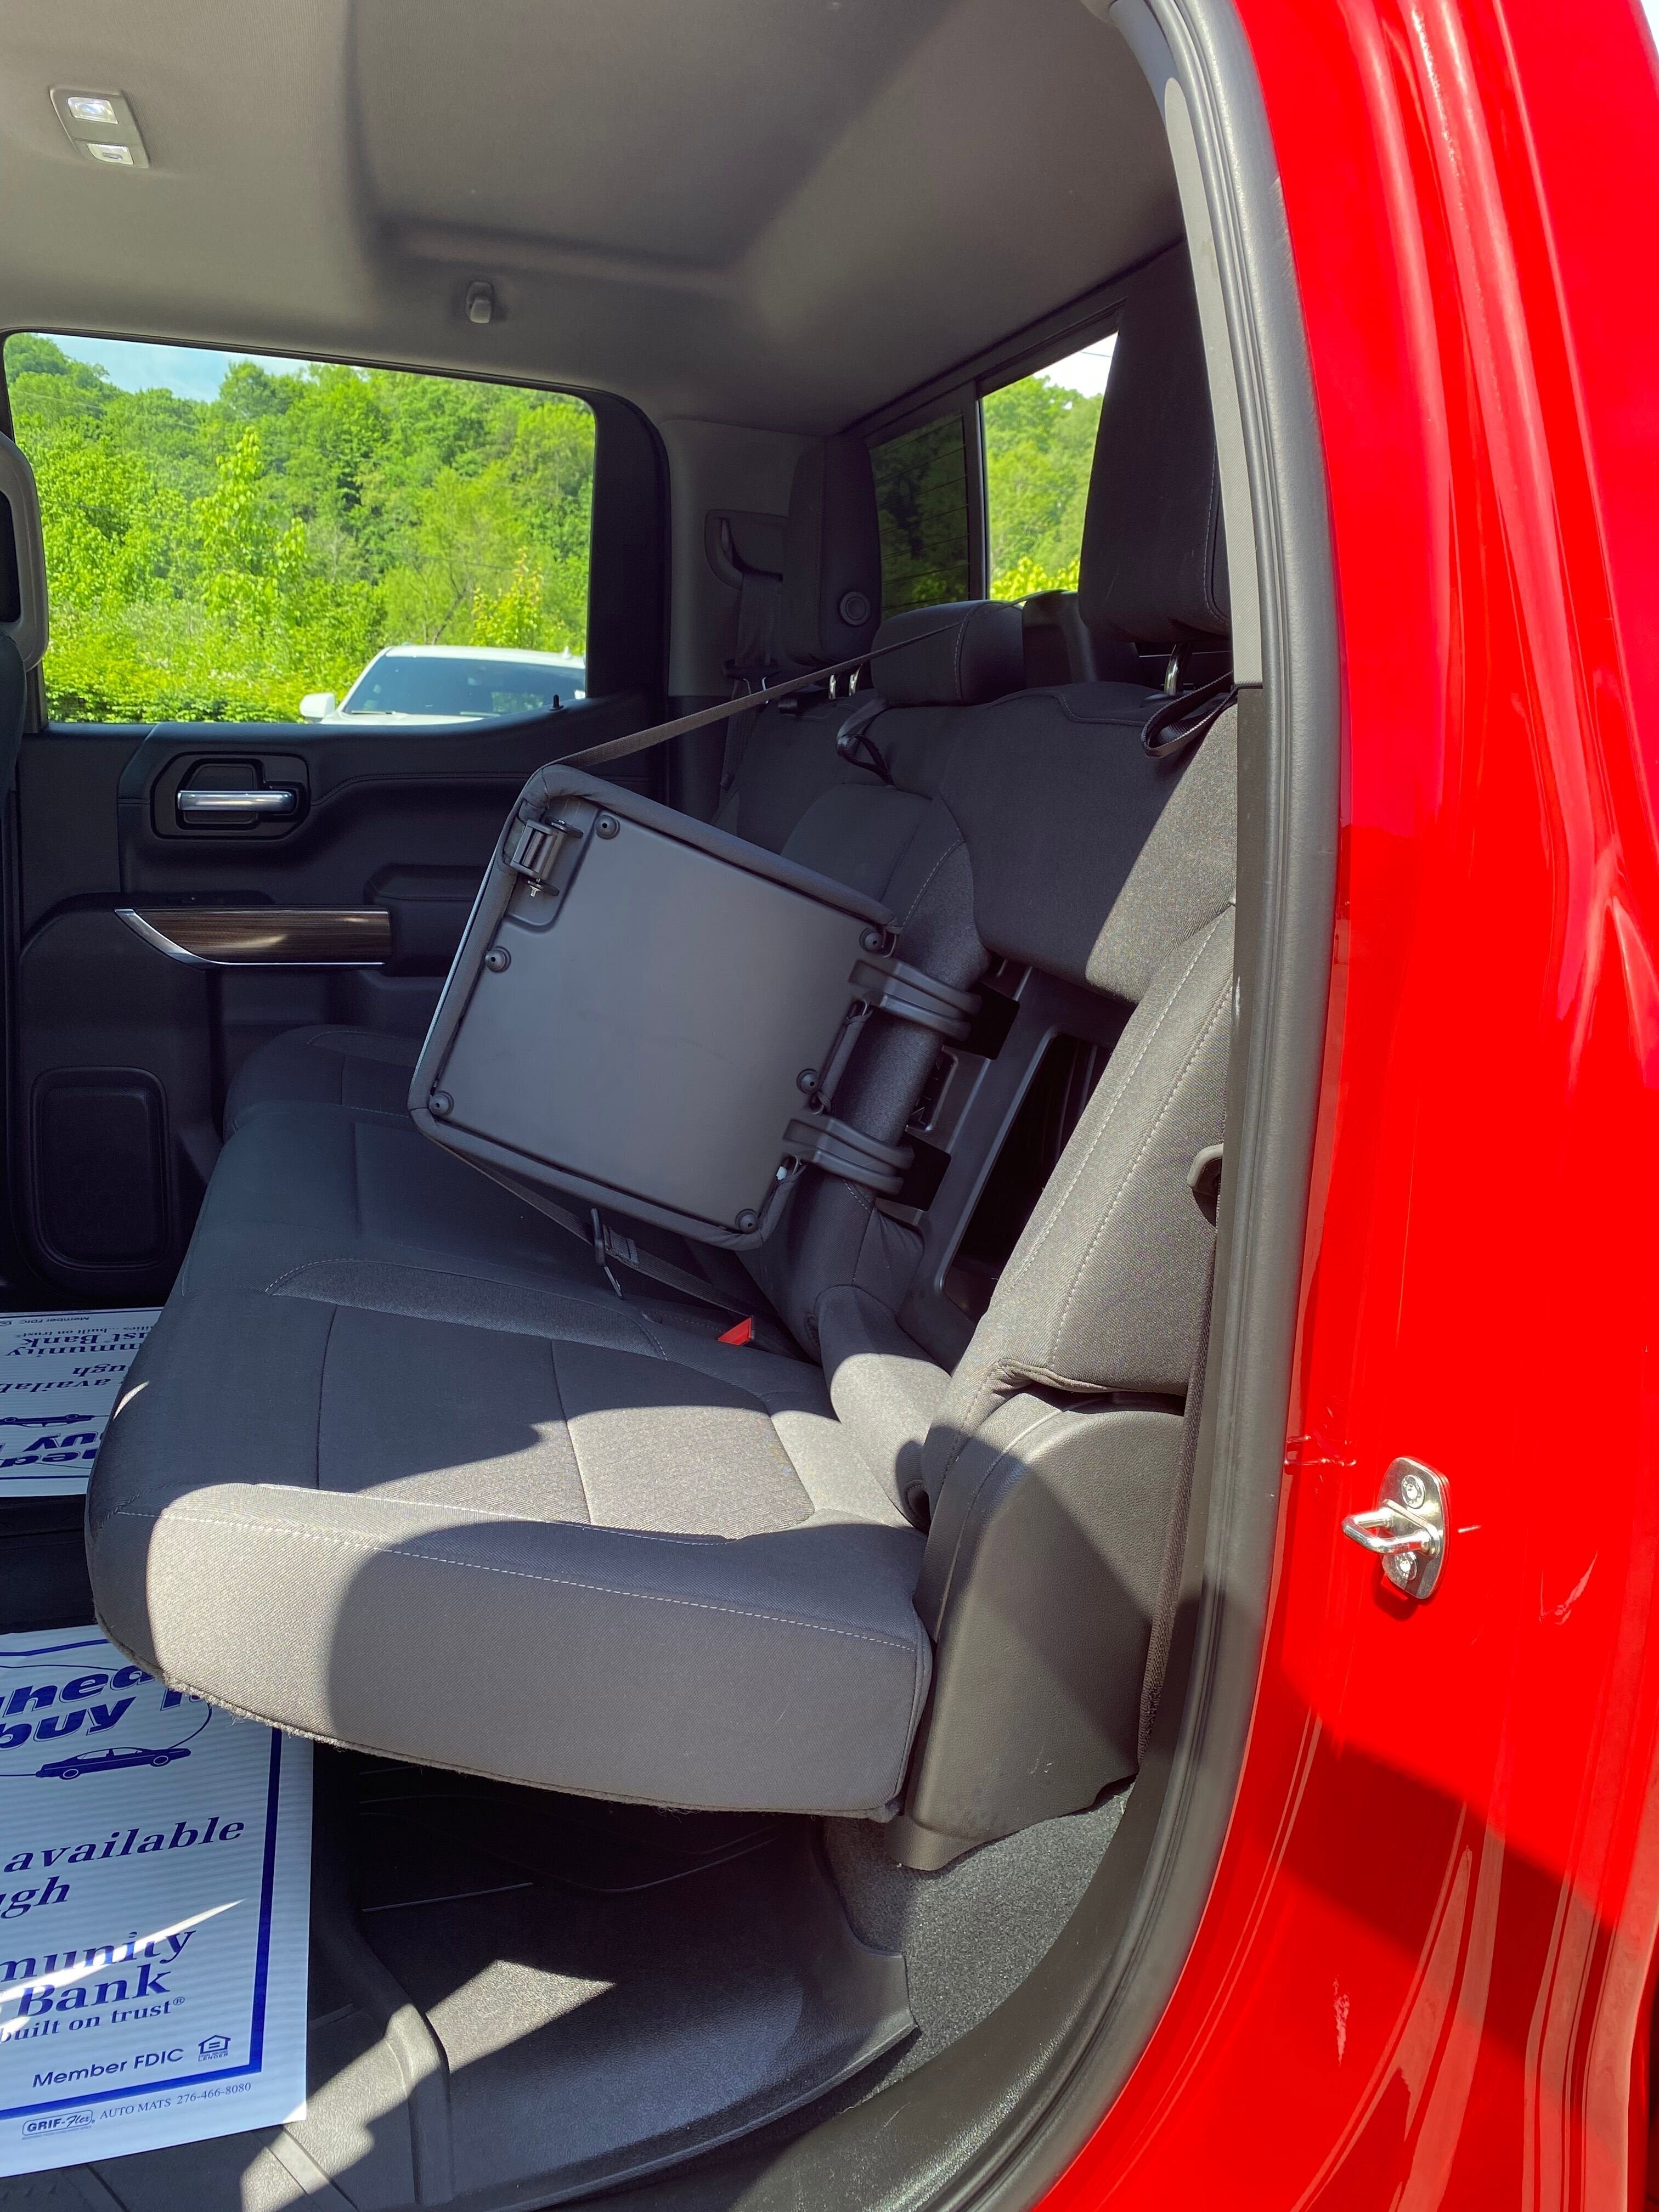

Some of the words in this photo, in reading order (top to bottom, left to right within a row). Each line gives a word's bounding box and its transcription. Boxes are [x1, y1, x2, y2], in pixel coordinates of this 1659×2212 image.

[20, 1334, 100, 1348] Bank
[22, 1431, 103, 1452] uy
[0, 1696, 137, 1751] buy
[4, 1816, 244, 1872] available
[12, 1963, 171, 2018] Bank
[69, 2016, 100, 2031] on
[32, 2061, 128, 2088] Member
[134, 2048, 184, 2069] FDIC
[198, 2053, 229, 2062] LENDER
[100, 2105, 134, 2120] AUTO
[138, 2098, 171, 2113] MATS
[177, 2082, 252, 2105] 276-466-8080
